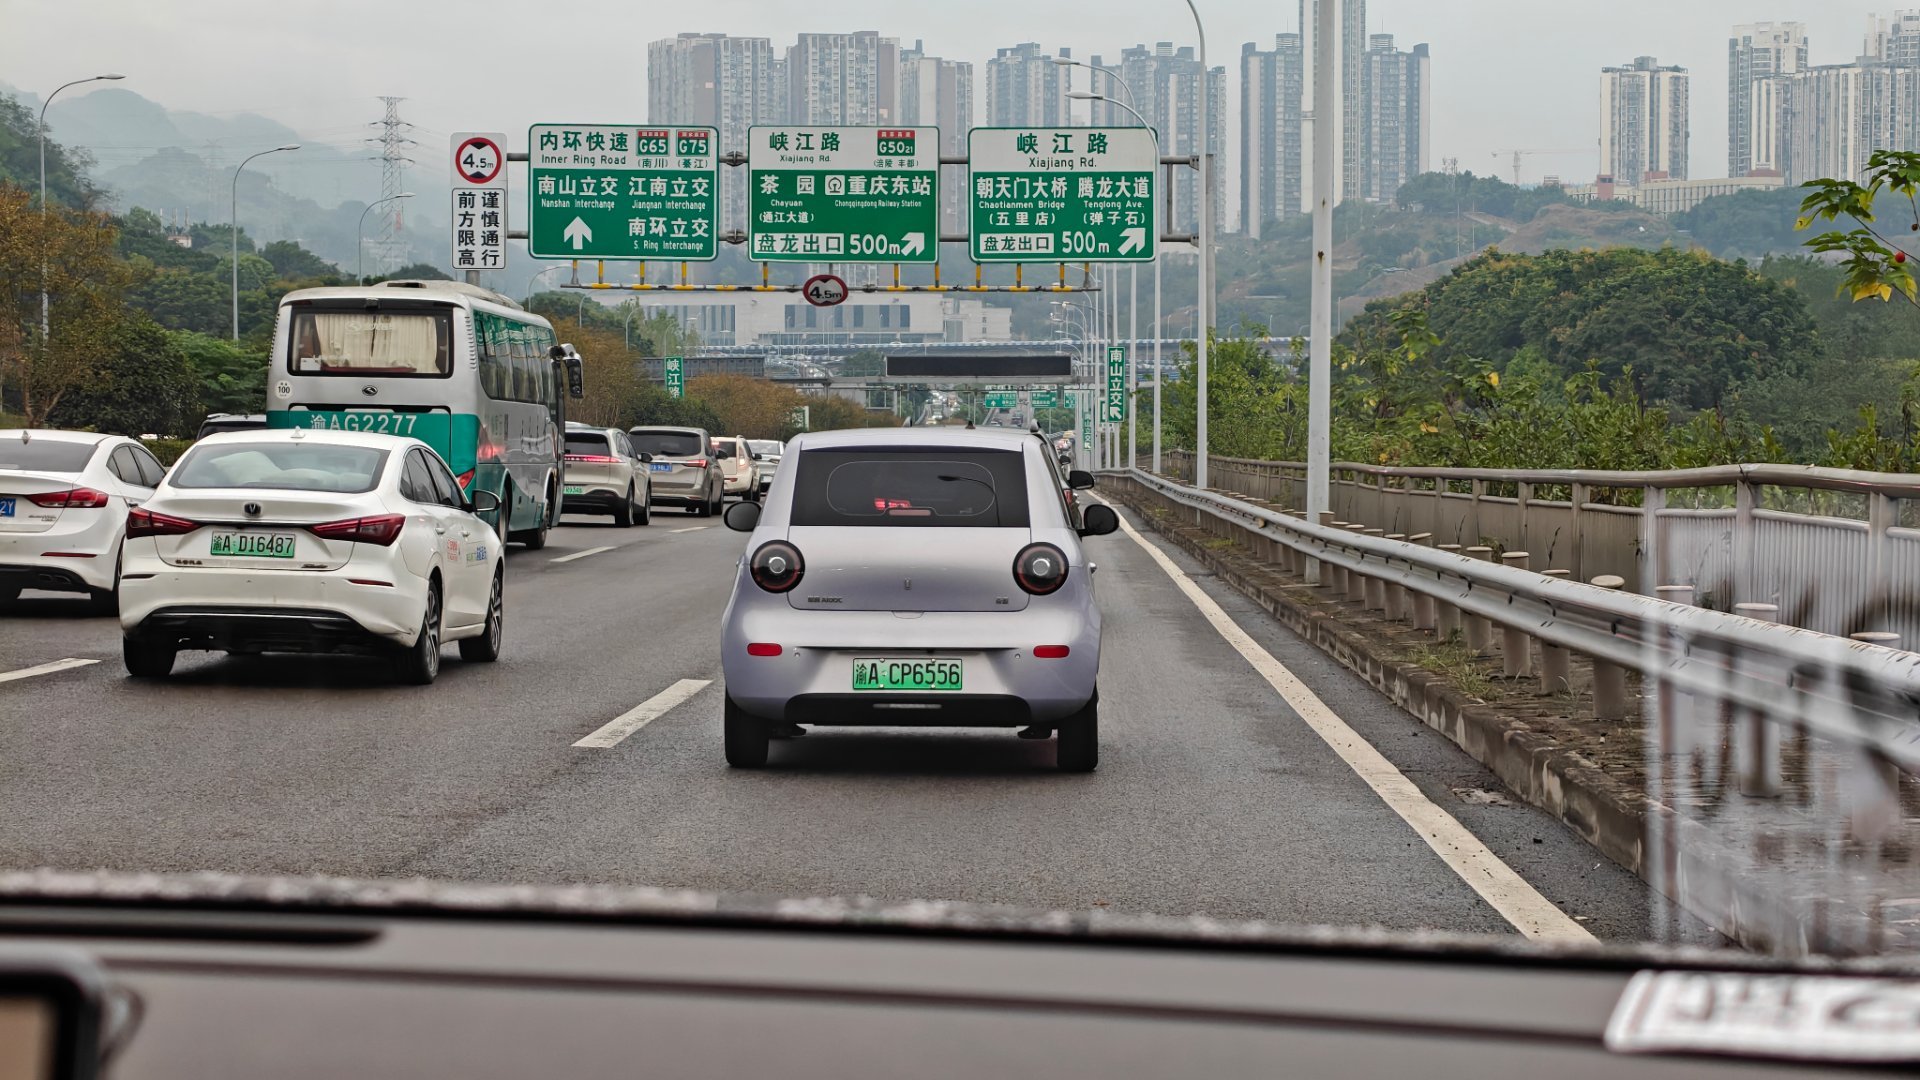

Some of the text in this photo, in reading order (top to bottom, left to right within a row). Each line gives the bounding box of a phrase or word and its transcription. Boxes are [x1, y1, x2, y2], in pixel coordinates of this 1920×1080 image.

[540, 131, 629, 152] 内环快速
[639, 139, 667, 153] G65
[679, 139, 707, 154] G75
[769, 132, 840, 152] 峡江路
[1016, 133, 1108, 154] 峡江路
[463, 153, 494, 169] 4.5m
[541, 155, 626, 166] Inner Ring Road
[780, 155, 814, 164] Xiajiang
[1029, 157, 1097, 170] Xiajiang Rd.
[538, 175, 619, 196] 南山立交
[628, 176, 709, 198] 江南立交
[760, 174, 815, 195] 茶园
[847, 175, 931, 196] 重庆东站
[976, 176, 1068, 199] 朝天门大桥
[1077, 176, 1150, 198] 腾龙大道
[541, 199, 615, 210] Nanshan Interchange
[631, 200, 706, 211] Jiangnan Interchange
[771, 199, 803, 208] Chayuan
[878, 200, 900, 208] Railway
[1038, 201, 1065, 209] Bridge
[1084, 201, 1121, 209] Tenglong
[458, 192, 476, 266] 前方限高
[481, 192, 499, 266] 谨慎通行
[628, 217, 709, 238] 南环立交
[643, 241, 659, 251] Ring
[663, 241, 704, 252] Interchange
[758, 233, 841, 254] 盘龙出口
[849, 233, 900, 255] 500m
[983, 236, 1050, 252] 盘龙出口
[810, 286, 842, 299] 4.5m
[667, 359, 681, 398] 峡江路
[1110, 349, 1123, 406] 南山立交
[278, 386, 291, 394] 100
[310, 414, 417, 434] 渝AG2277
